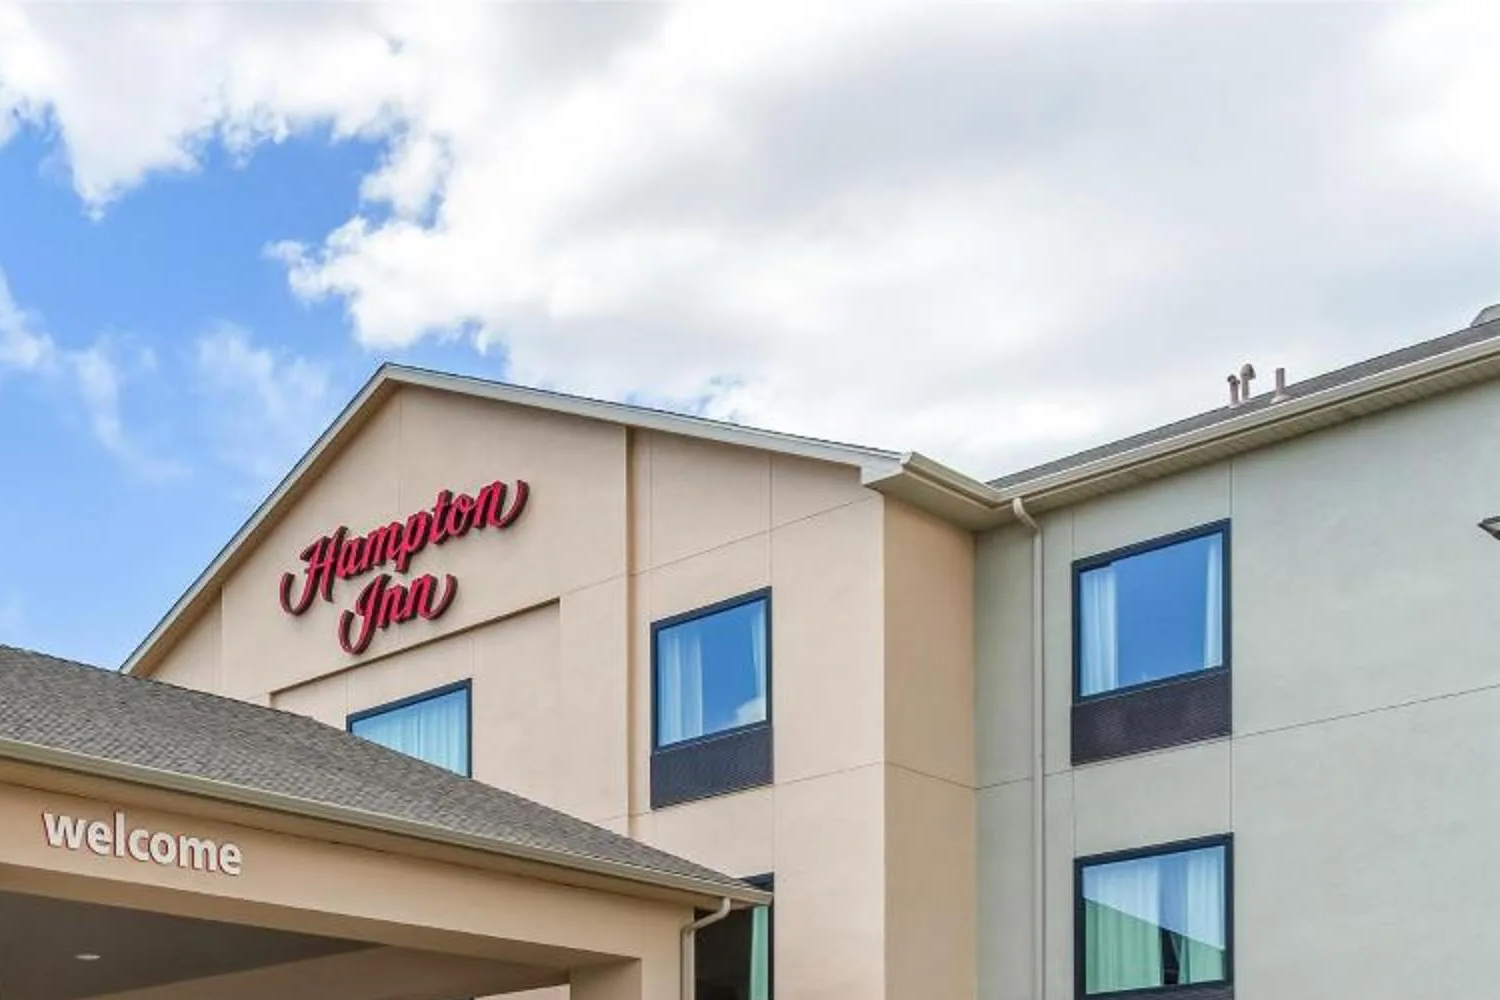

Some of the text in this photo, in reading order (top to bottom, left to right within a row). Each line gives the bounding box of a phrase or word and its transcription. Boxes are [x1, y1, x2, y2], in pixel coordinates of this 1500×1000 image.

[279, 479, 530, 616] Hampton
[338, 573, 458, 655] Inn
[42, 811, 242, 875] welcome
